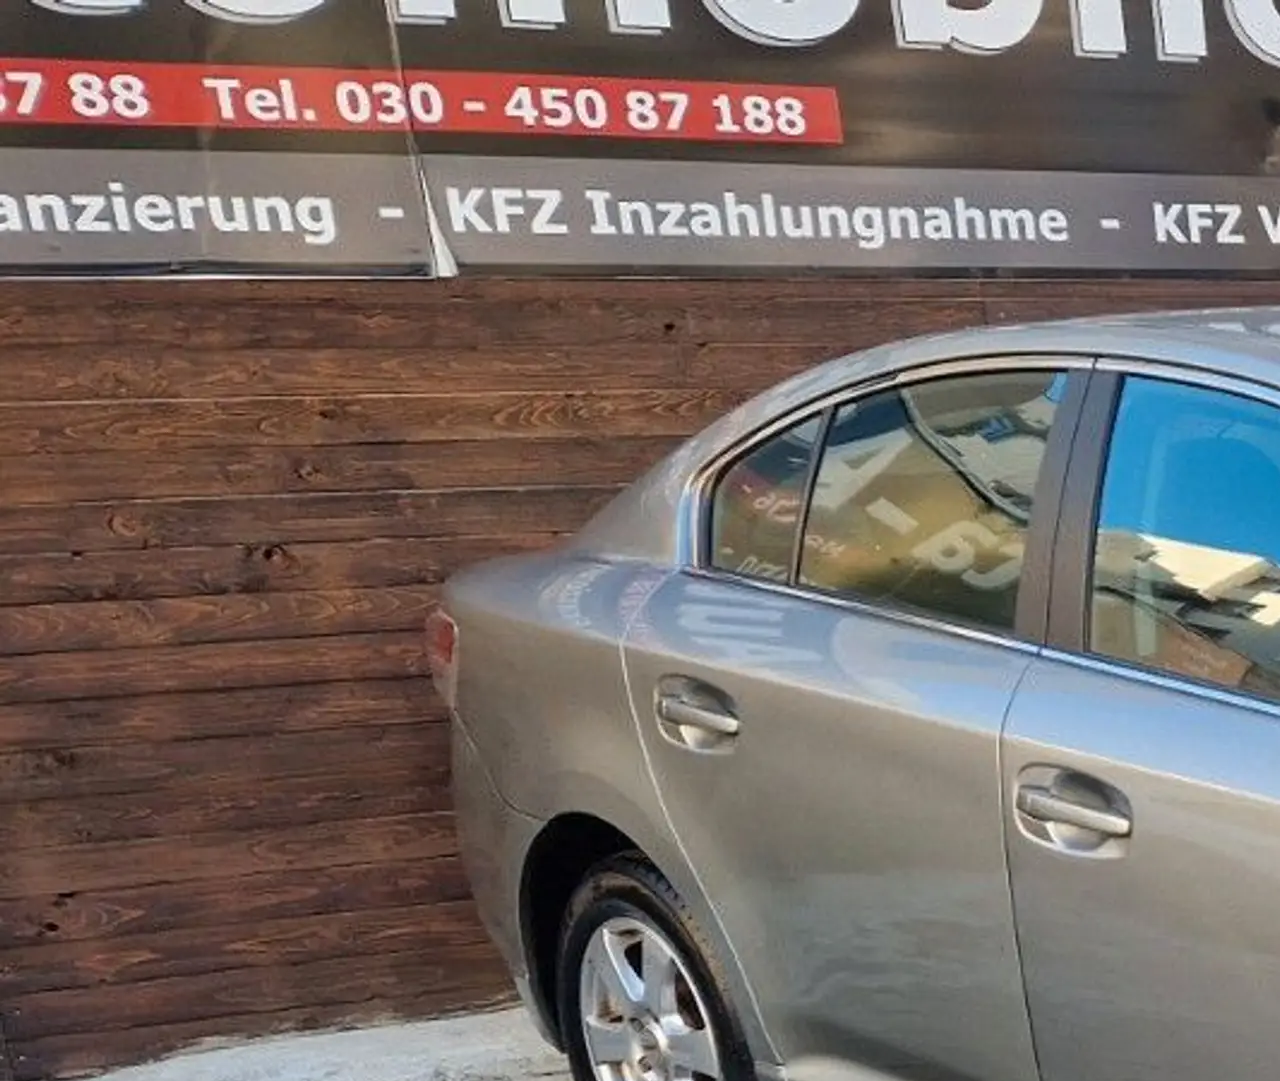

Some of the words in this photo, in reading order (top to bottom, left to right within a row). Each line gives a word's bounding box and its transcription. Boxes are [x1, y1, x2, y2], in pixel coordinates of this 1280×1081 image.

[68, 73, 151, 118] 88
[203, 78, 317, 122] Tel.
[335, 81, 444, 125] 030
[504, 86, 609, 129] 450
[626, 91, 690, 131] 87
[712, 94, 807, 136] 188
[445, 186, 570, 235] KFZ
[584, 189, 1070, 250] Inzahlungnahme
[1153, 202, 1245, 244] KFZ
